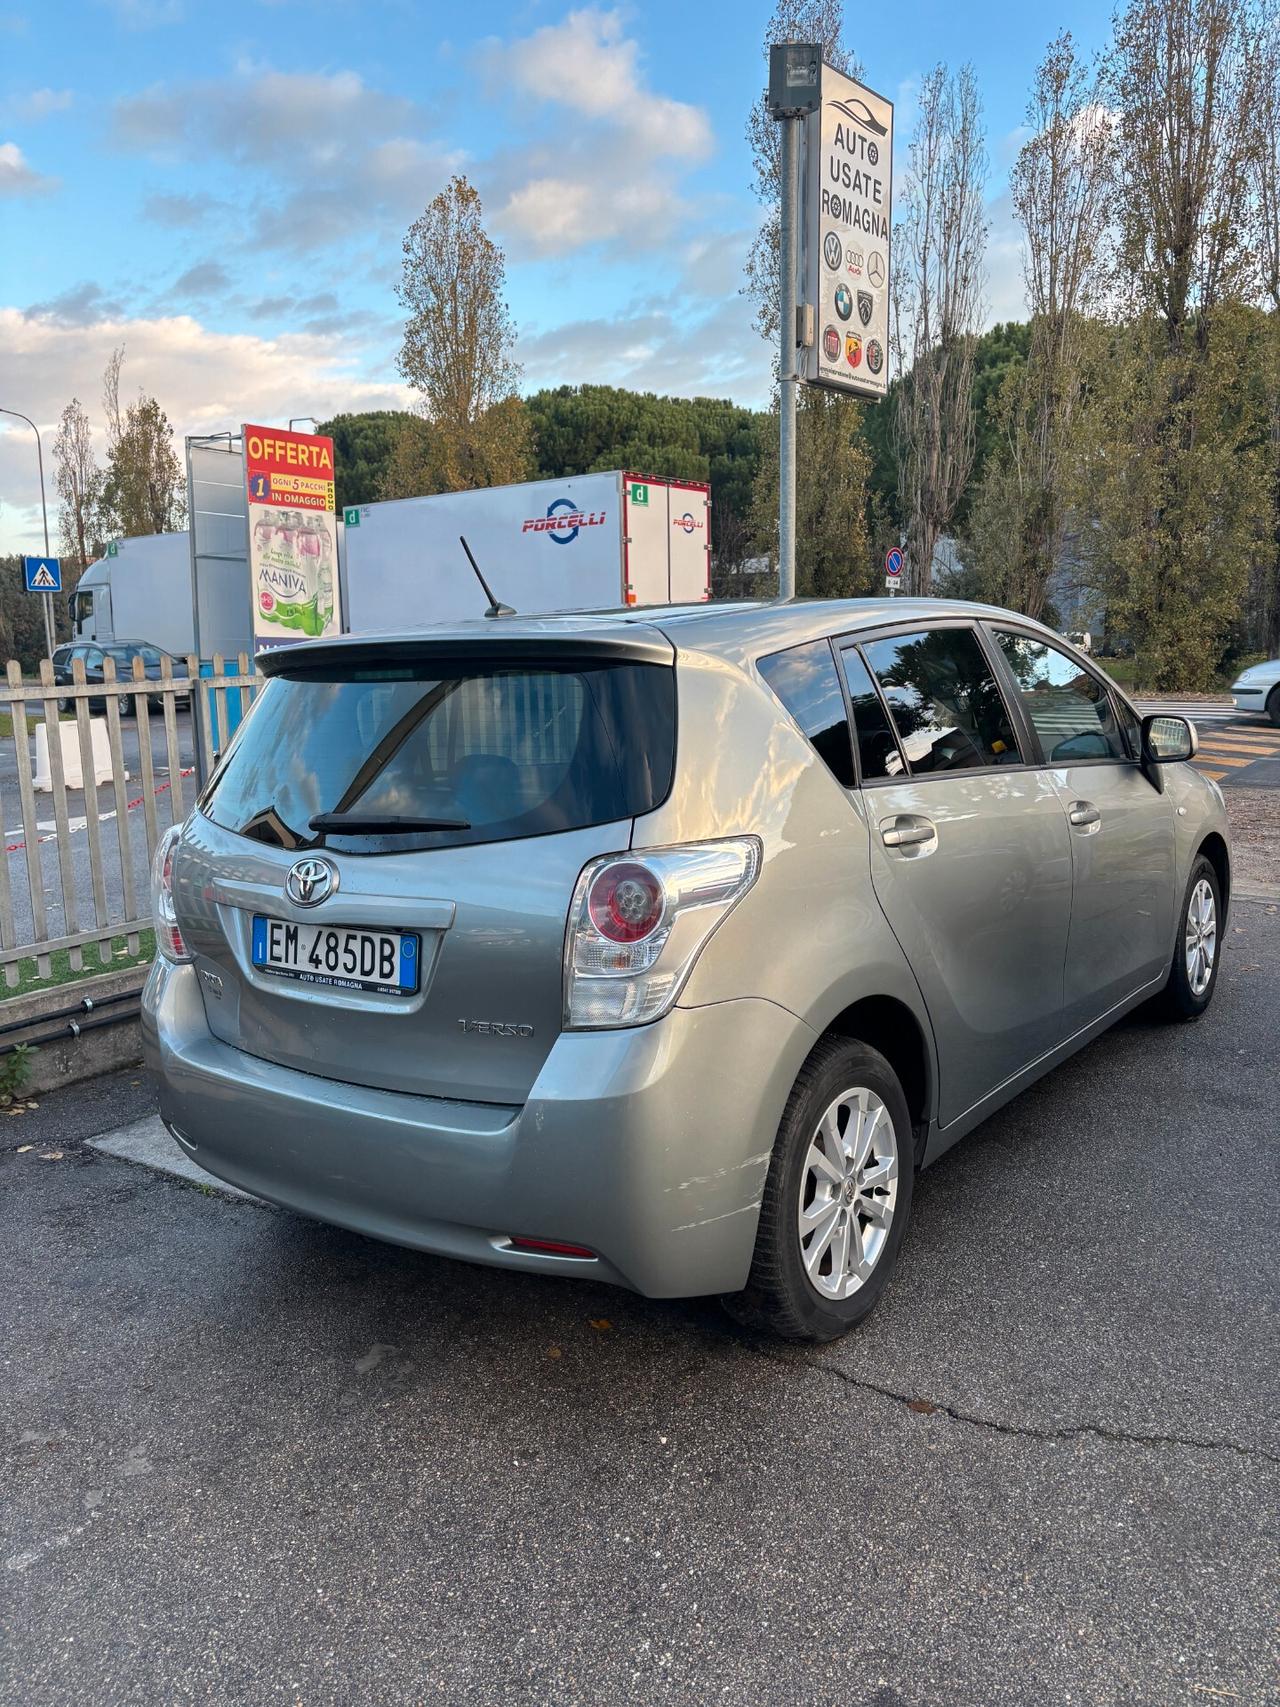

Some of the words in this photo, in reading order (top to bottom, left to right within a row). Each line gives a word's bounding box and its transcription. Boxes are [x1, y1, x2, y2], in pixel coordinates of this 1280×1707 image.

[834, 123, 879, 166] AUTO
[830, 155, 882, 205] USATE
[822, 188, 889, 241] ROMAGNA
[248, 436, 332, 470] OFFERTA
[256, 478, 264, 497] 1
[272, 477, 291, 486] OGNI
[292, 479, 300, 490] 5
[300, 481, 326, 491] PACCHI
[271, 492, 282, 501] IN
[284, 494, 326, 507] OMAGGIO
[522, 511, 606, 533] PORCELLI
[259, 568, 307, 595] MANIVA
[269, 923, 299, 965] EM
[308, 930, 396, 979] 485DB
[300, 973, 314, 982] AUTO
[315, 976, 332, 985] USATE
[333, 979, 363, 990] ROMAGNA
[457, 1018, 535, 1038] VERSO
